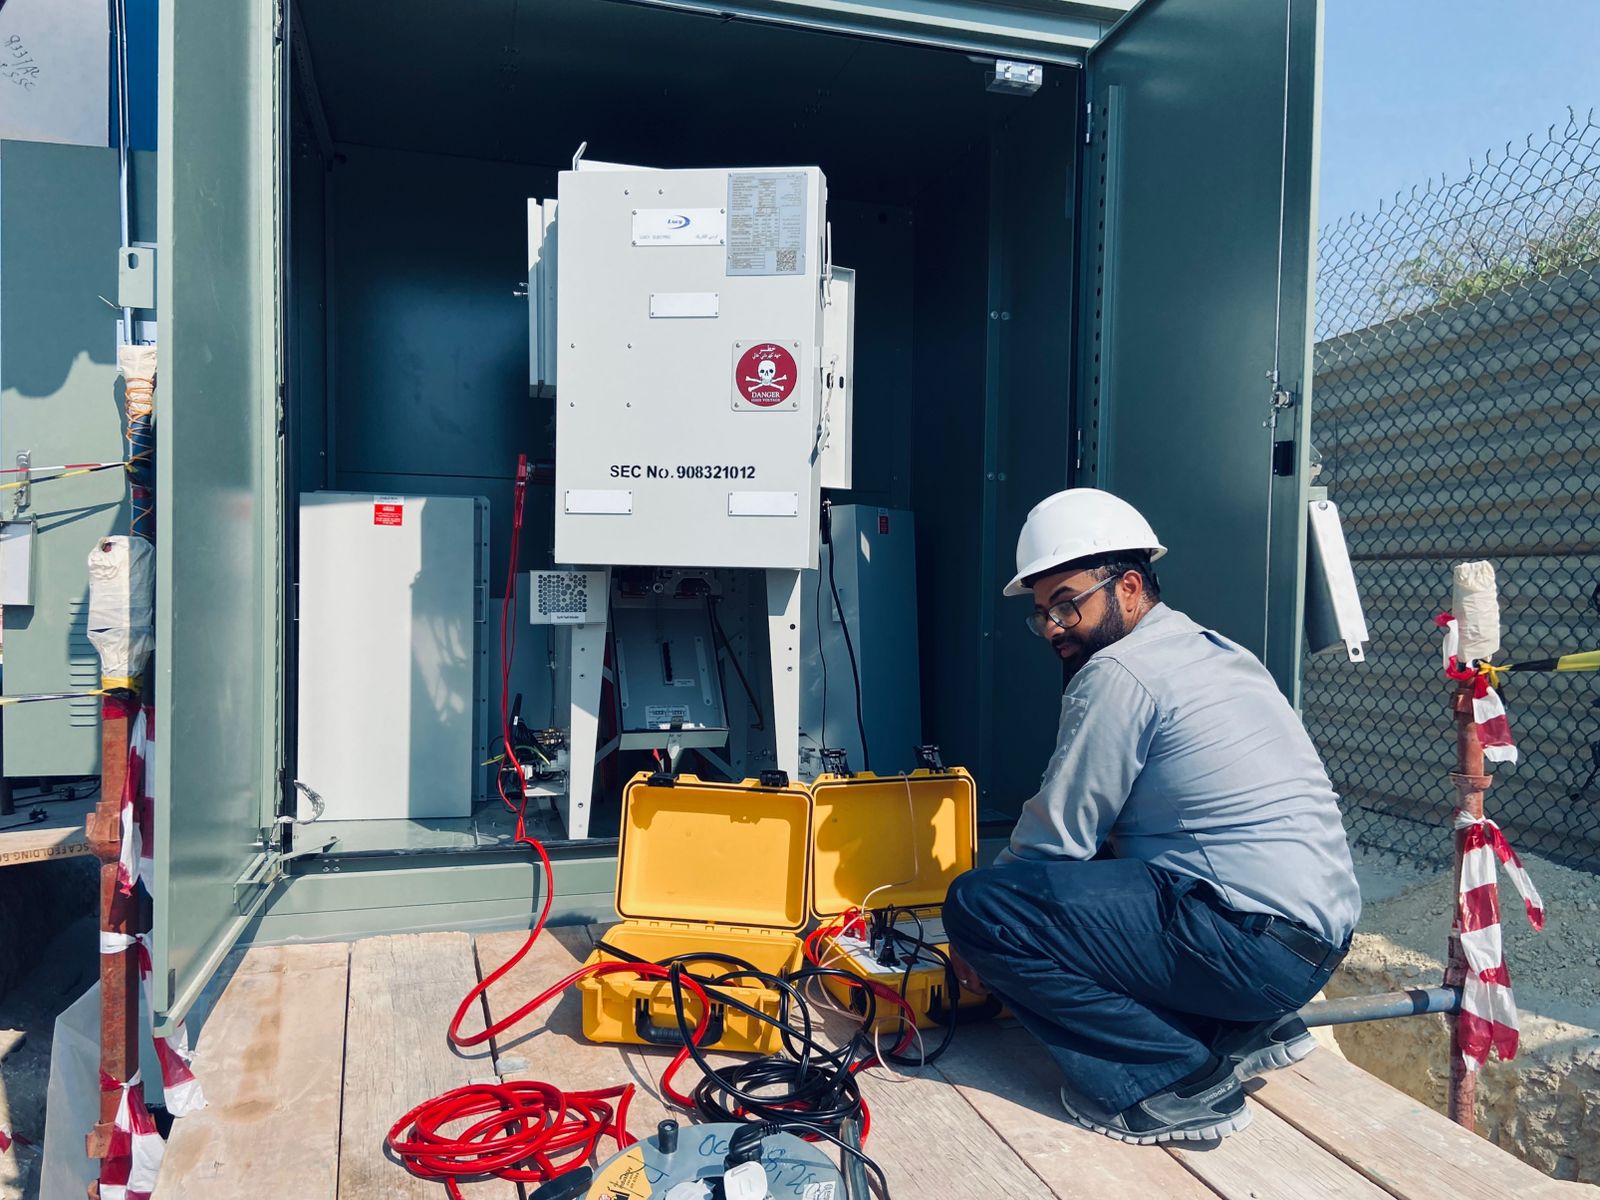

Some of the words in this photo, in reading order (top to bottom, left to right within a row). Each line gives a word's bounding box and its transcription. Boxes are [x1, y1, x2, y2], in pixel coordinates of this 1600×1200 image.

[610, 465, 642, 478] SEC
[646, 465, 674, 479] No.
[676, 465, 756, 479] 908321012
[14, 842, 90, 861] SCAFFOLDING
[1200, 1088, 1226, 1104] Reebok
